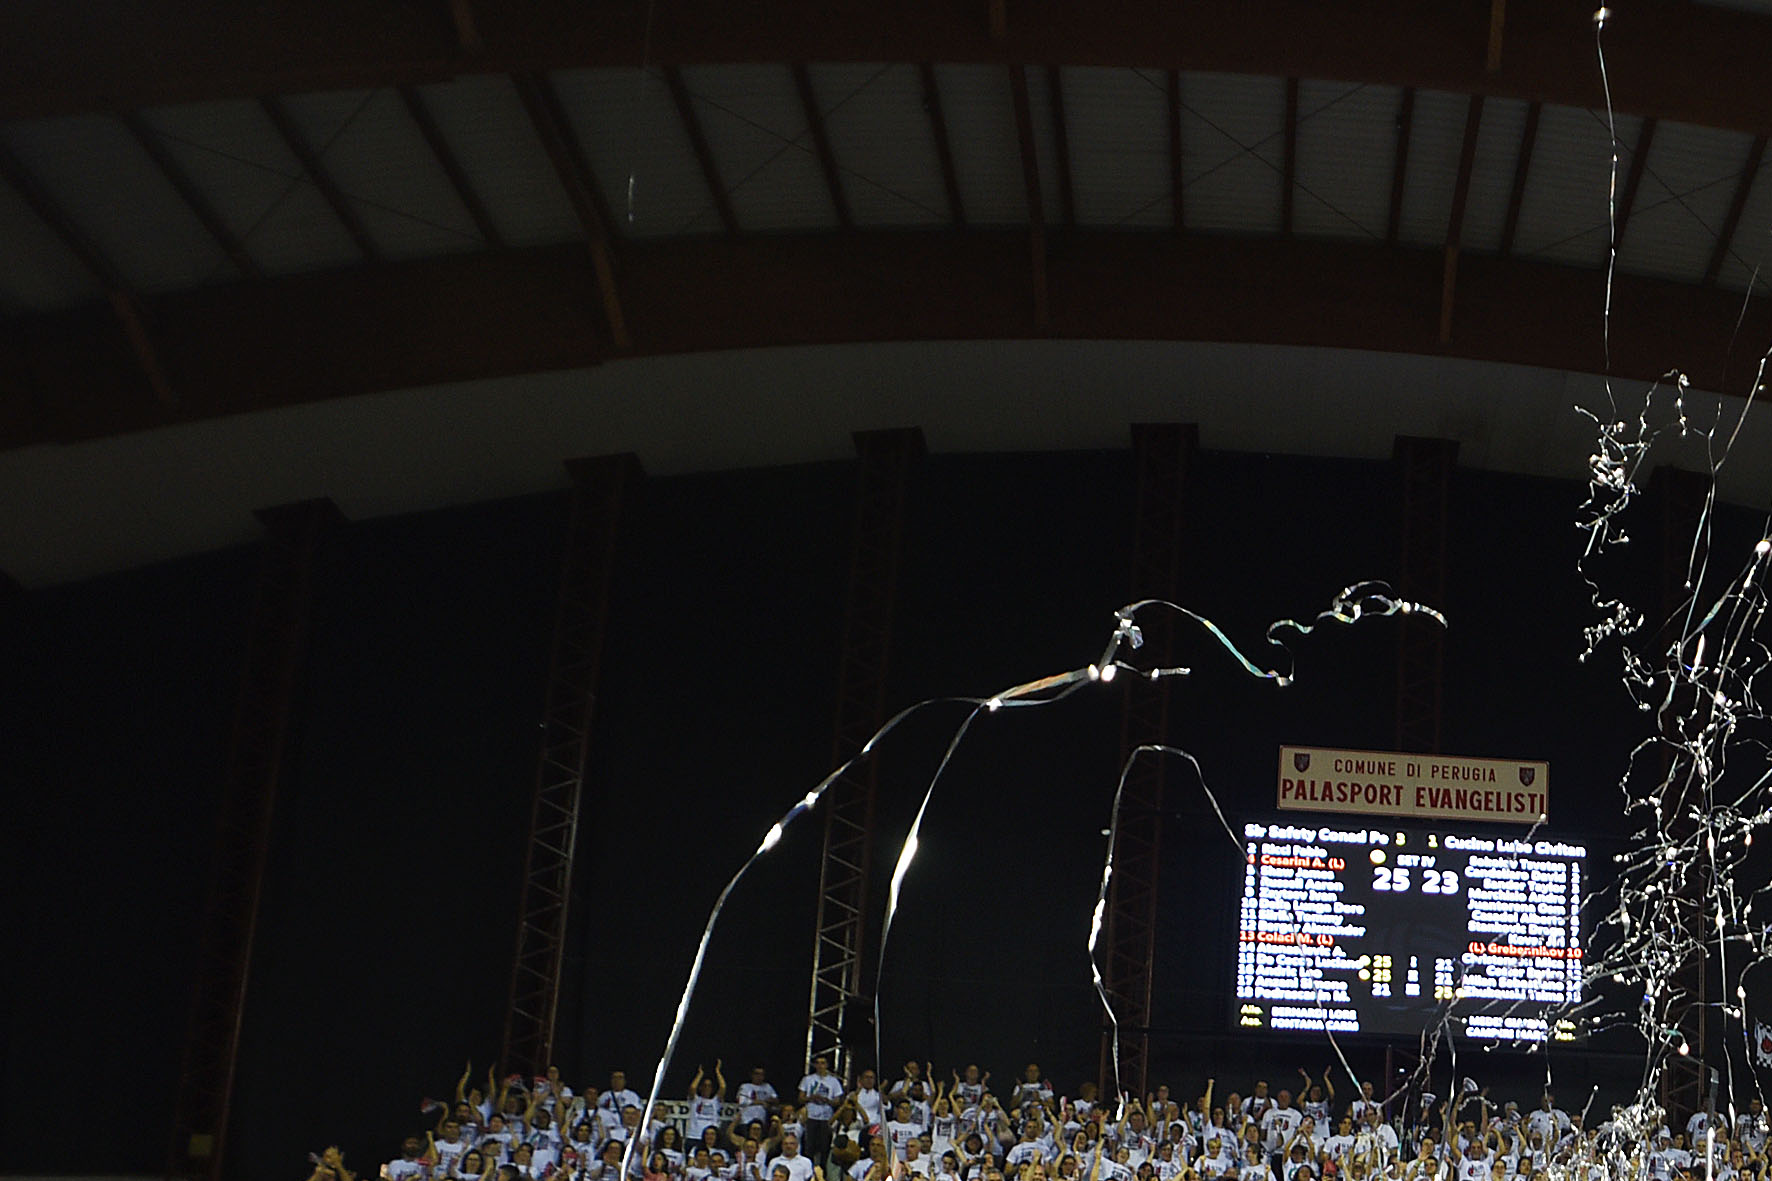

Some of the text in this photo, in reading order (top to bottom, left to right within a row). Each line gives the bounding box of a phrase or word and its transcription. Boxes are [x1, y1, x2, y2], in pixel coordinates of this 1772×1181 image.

[1334, 758, 1496, 783] COMUNE DI PERUGIA
[1281, 778, 1546, 814] PALASPORT EVANGELISTI
[1395, 832, 1406, 846] 3
[1428, 834, 1438, 848] 1
[1260, 853, 1345, 870] Cesarini A. (L)
[1372, 866, 1459, 895] 25 23
[1239, 930, 1256, 941] 13
[1256, 931, 1295, 943] Colaci
[1316, 934, 1334, 946] (L)
[1372, 955, 1392, 968] 25
[1372, 969, 1392, 982] 25
